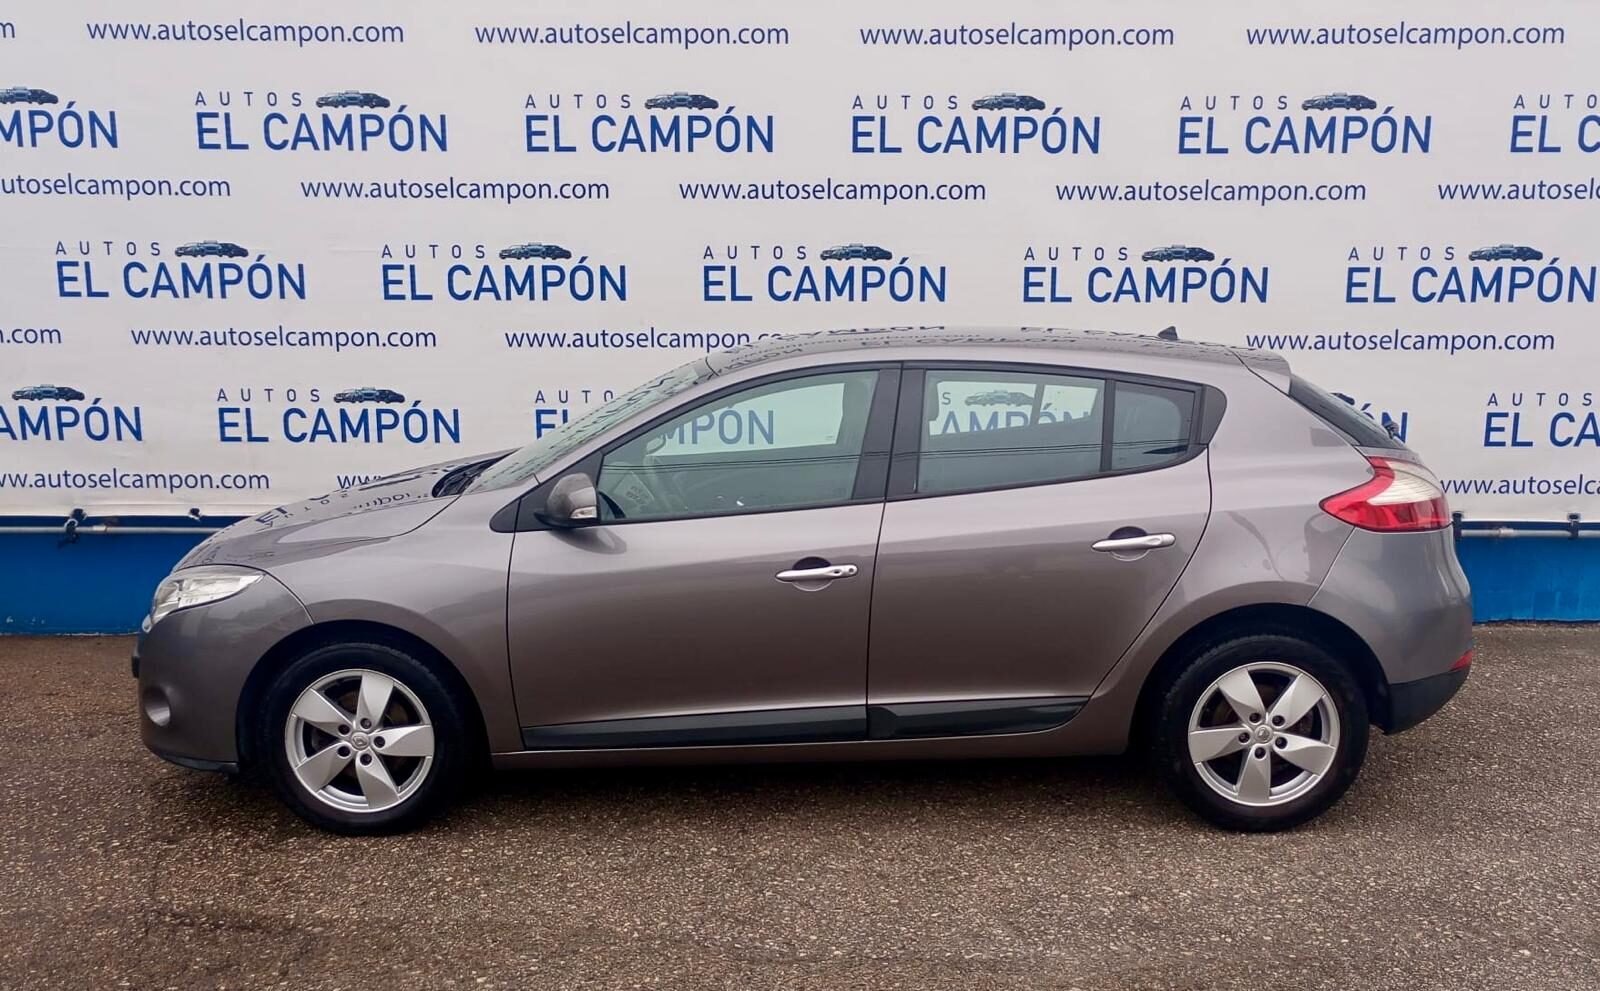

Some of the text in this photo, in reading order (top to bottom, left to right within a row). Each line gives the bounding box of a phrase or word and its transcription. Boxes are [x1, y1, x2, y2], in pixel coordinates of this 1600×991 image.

[86, 17, 404, 48] www.autoselcampon.com
[474, 20, 789, 50] www.autoselcampon.com
[859, 21, 1174, 52] www.autoselcampon.com
[1246, 20, 1565, 51] www.autoselcampon.com
[194, 91, 302, 108] AUTOS
[524, 93, 631, 109] AUTOS
[851, 94, 958, 111] AUTOS
[1180, 95, 1288, 111] AUTOS
[195, 104, 448, 153] EL CAMPÓN
[525, 103, 774, 153] EL CAMPÓN
[851, 105, 1101, 155] EL CAMPÓN
[1177, 104, 1432, 155] EL CAMPÓN
[1509, 114, 1562, 154] EL
[300, 176, 610, 205] www.autoselcampon.com
[678, 177, 986, 206] www.autoselcampon.com
[1055, 178, 1366, 207] www.autoselcampon.com
[55, 240, 161, 257] AUTOS
[381, 244, 486, 260] AUTOS
[703, 245, 807, 261] AUTOS
[1023, 246, 1128, 262] AUTOS
[1347, 246, 1455, 262] AUTOS
[56, 253, 306, 300] EL CAMPÓN
[381, 255, 627, 302] EL CAMPÓN
[703, 256, 947, 303] EL CAMPÓN
[1022, 255, 1269, 304] EL CAMPÓN
[1345, 254, 1597, 304] EL CAMPÓN
[130, 324, 437, 353] www.autoselcampon.com
[1246, 328, 1556, 355] www.autoselcampon.com
[216, 387, 321, 403] AUTOS
[535, 390, 614, 403] AUTO
[1487, 392, 1593, 407] AUTOS
[217, 399, 461, 444] EL CAMPÓN
[1483, 411, 1534, 448] EL
